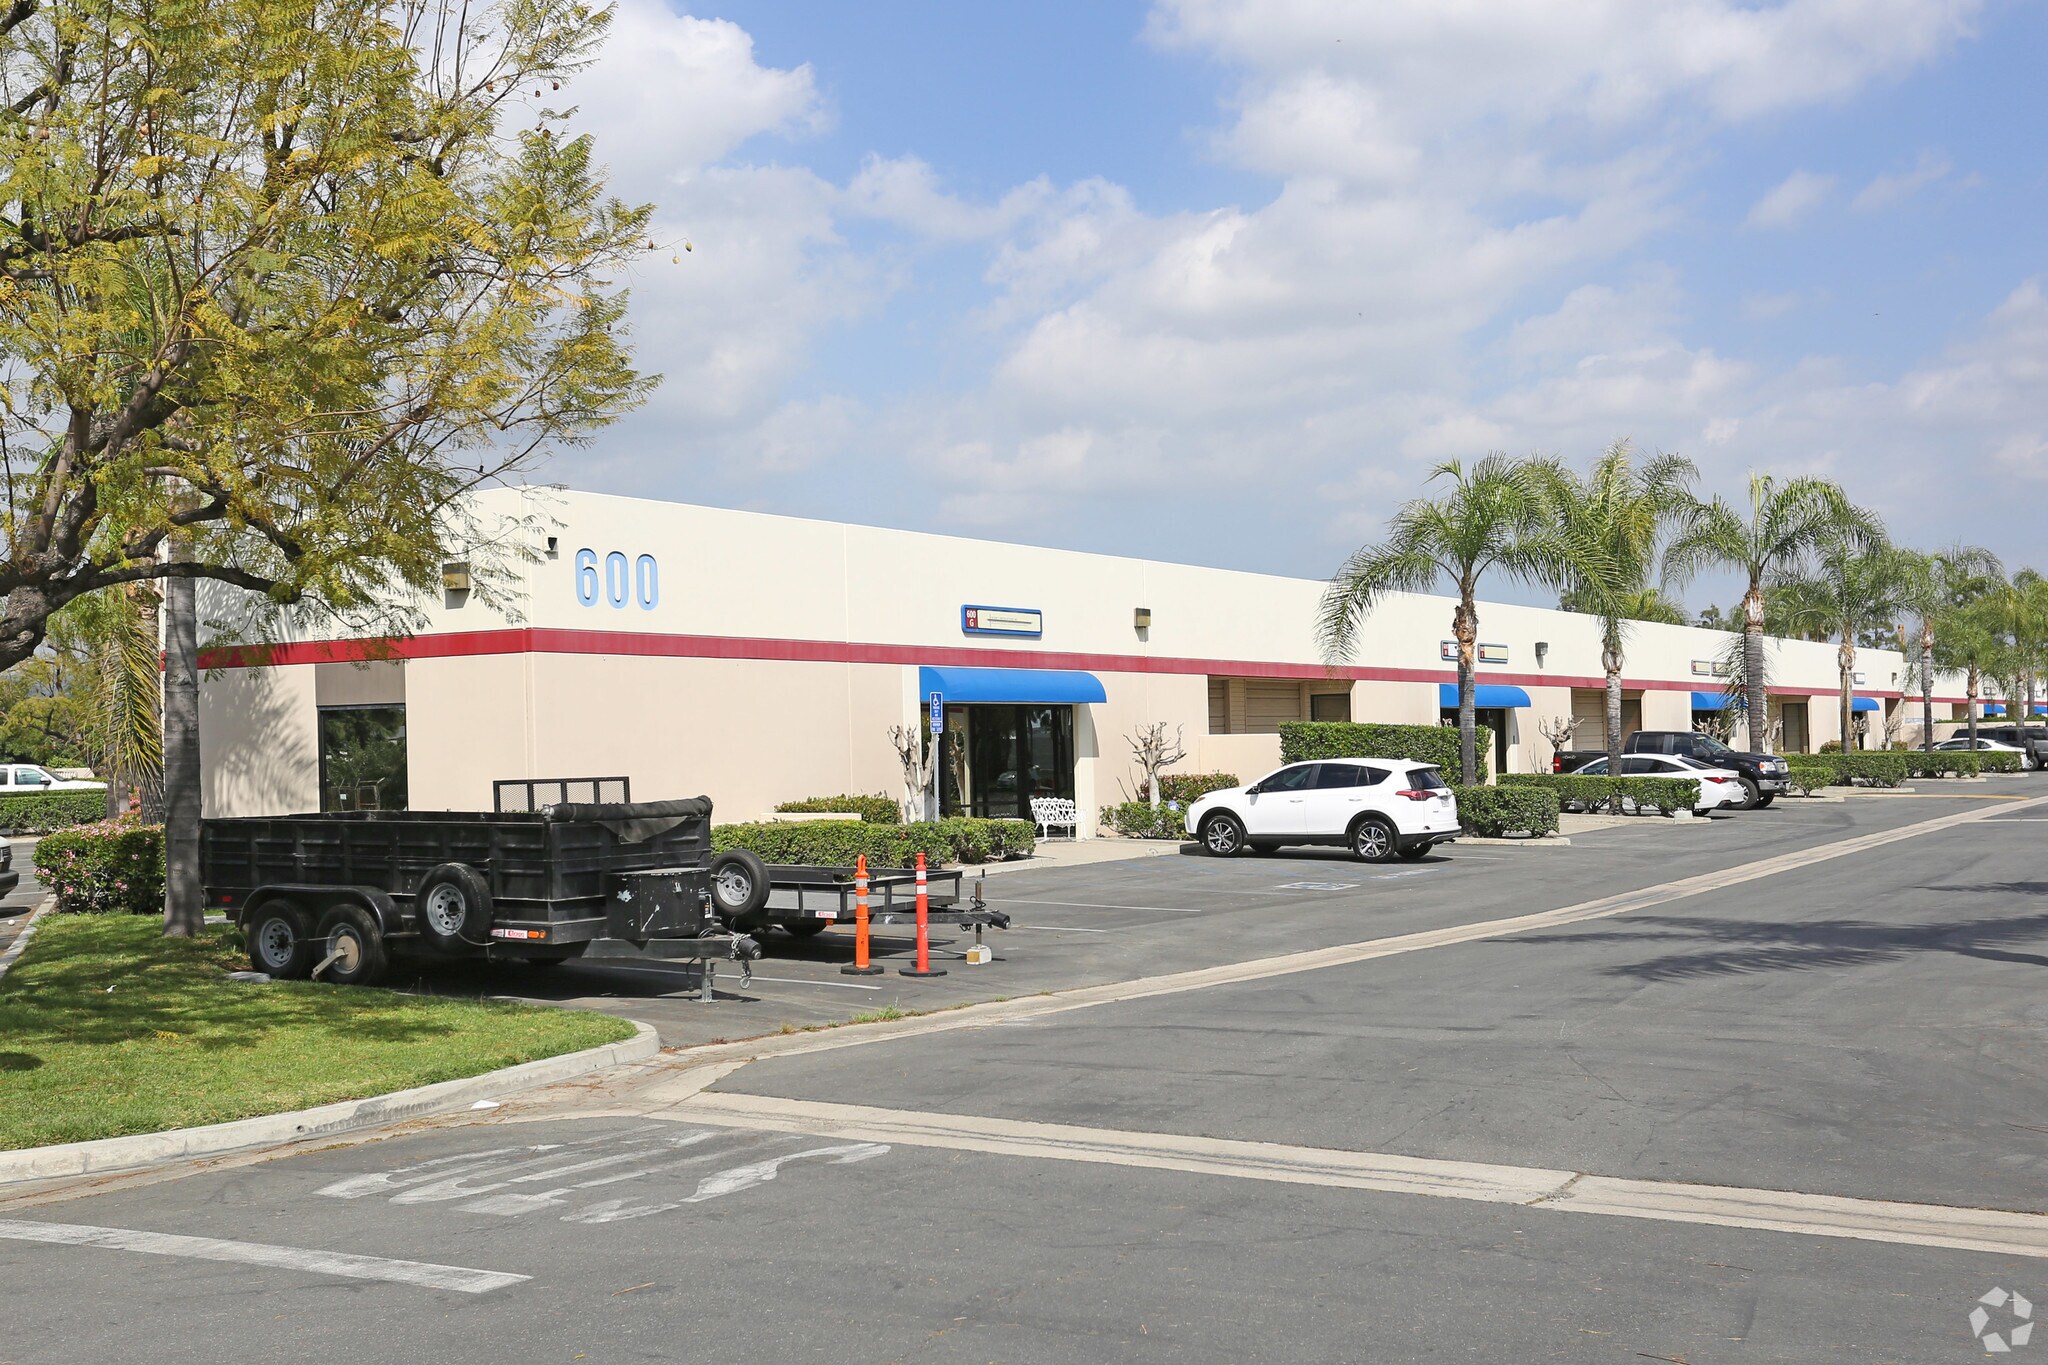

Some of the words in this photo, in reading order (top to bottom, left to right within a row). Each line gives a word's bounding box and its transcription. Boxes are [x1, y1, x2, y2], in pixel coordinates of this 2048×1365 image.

[575, 547, 659, 611] 600
[966, 610, 976, 618] 600
[969, 618, 975, 627] G
[312, 1124, 893, 1225] STOP
